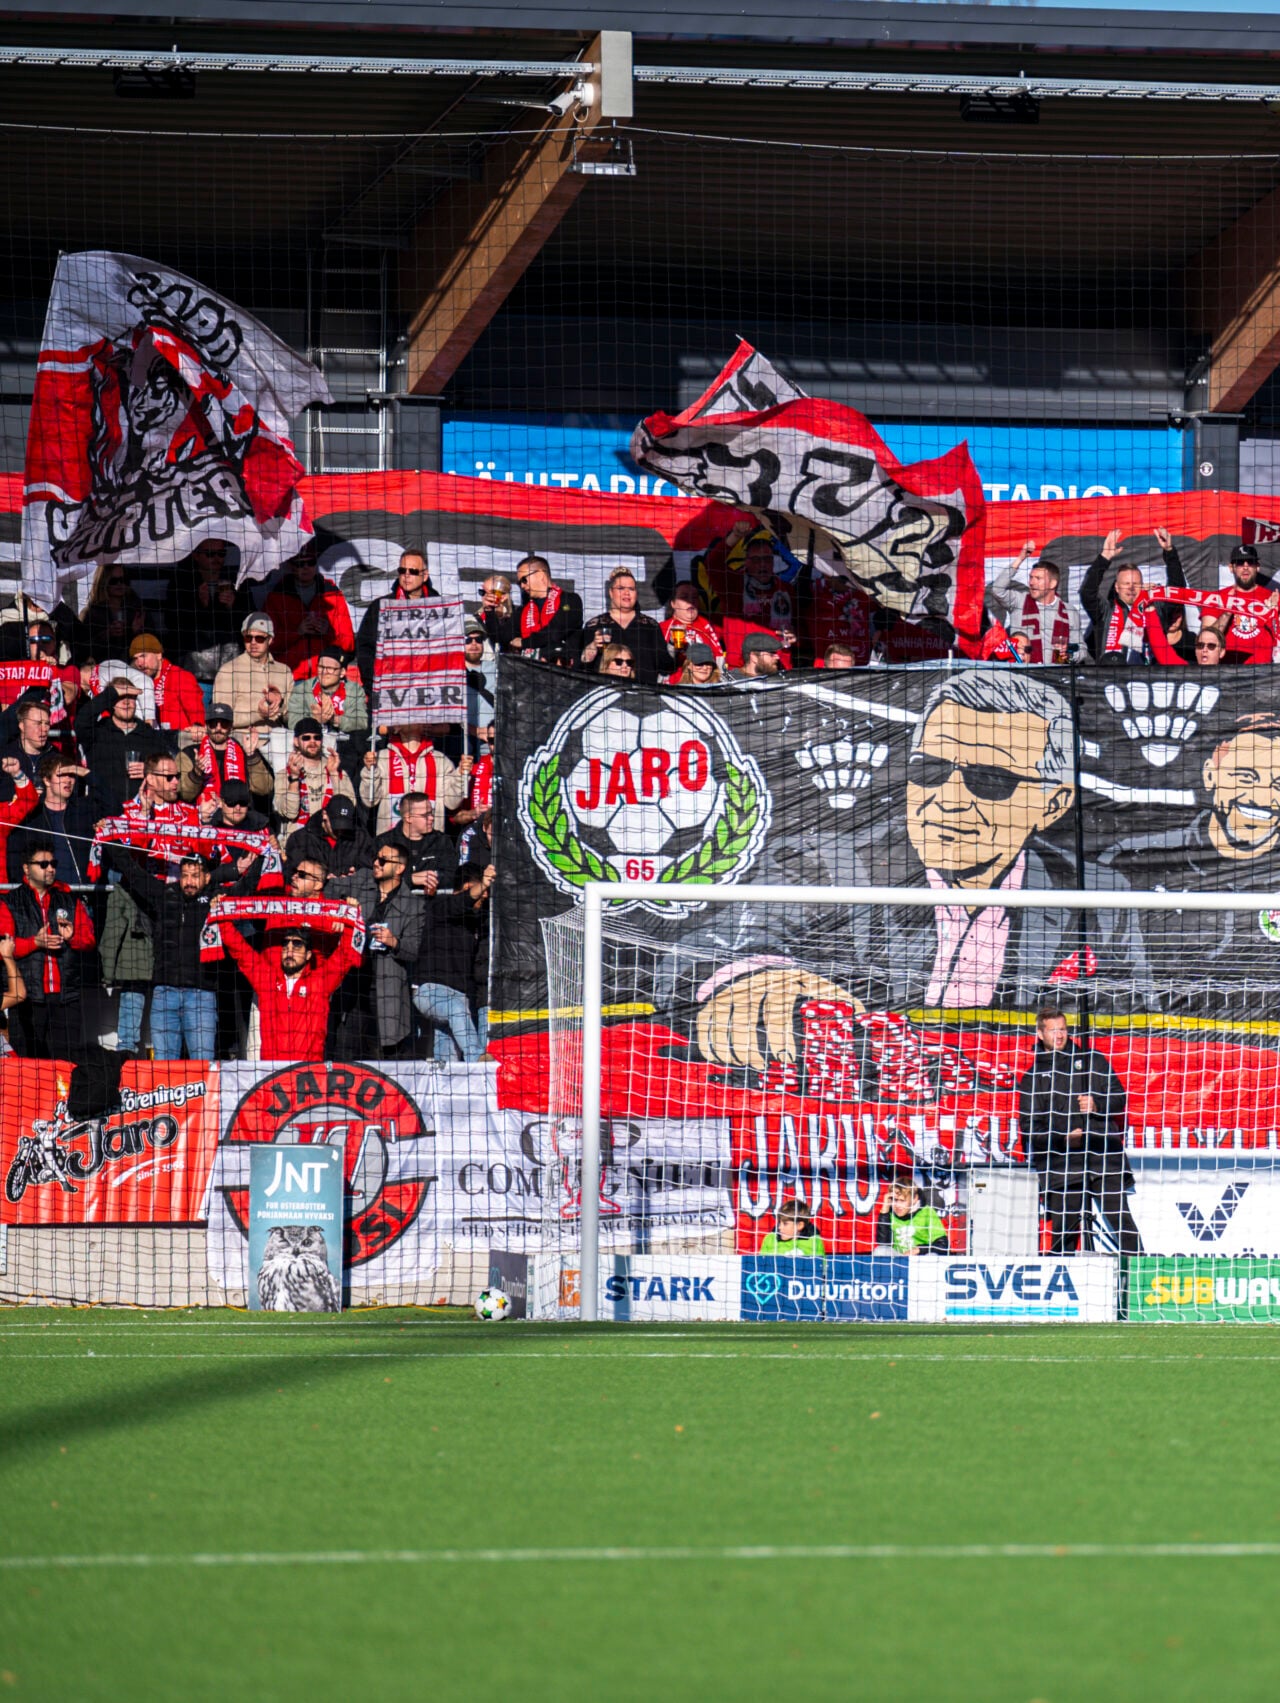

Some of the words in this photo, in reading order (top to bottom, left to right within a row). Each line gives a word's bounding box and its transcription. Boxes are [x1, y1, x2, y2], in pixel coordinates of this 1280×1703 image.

[1188, 591, 1271, 617] JARO
[575, 739, 709, 811] JARO
[625, 860, 655, 881] 65
[245, 900, 322, 915] JARO
[266, 1069, 386, 1119] JARO
[60, 1113, 179, 1180] Jaro
[263, 1151, 330, 1198] JNT
[604, 1275, 717, 1302] STARK
[787, 1278, 905, 1301] Duunitori
[945, 1263, 1080, 1301] SVEA
